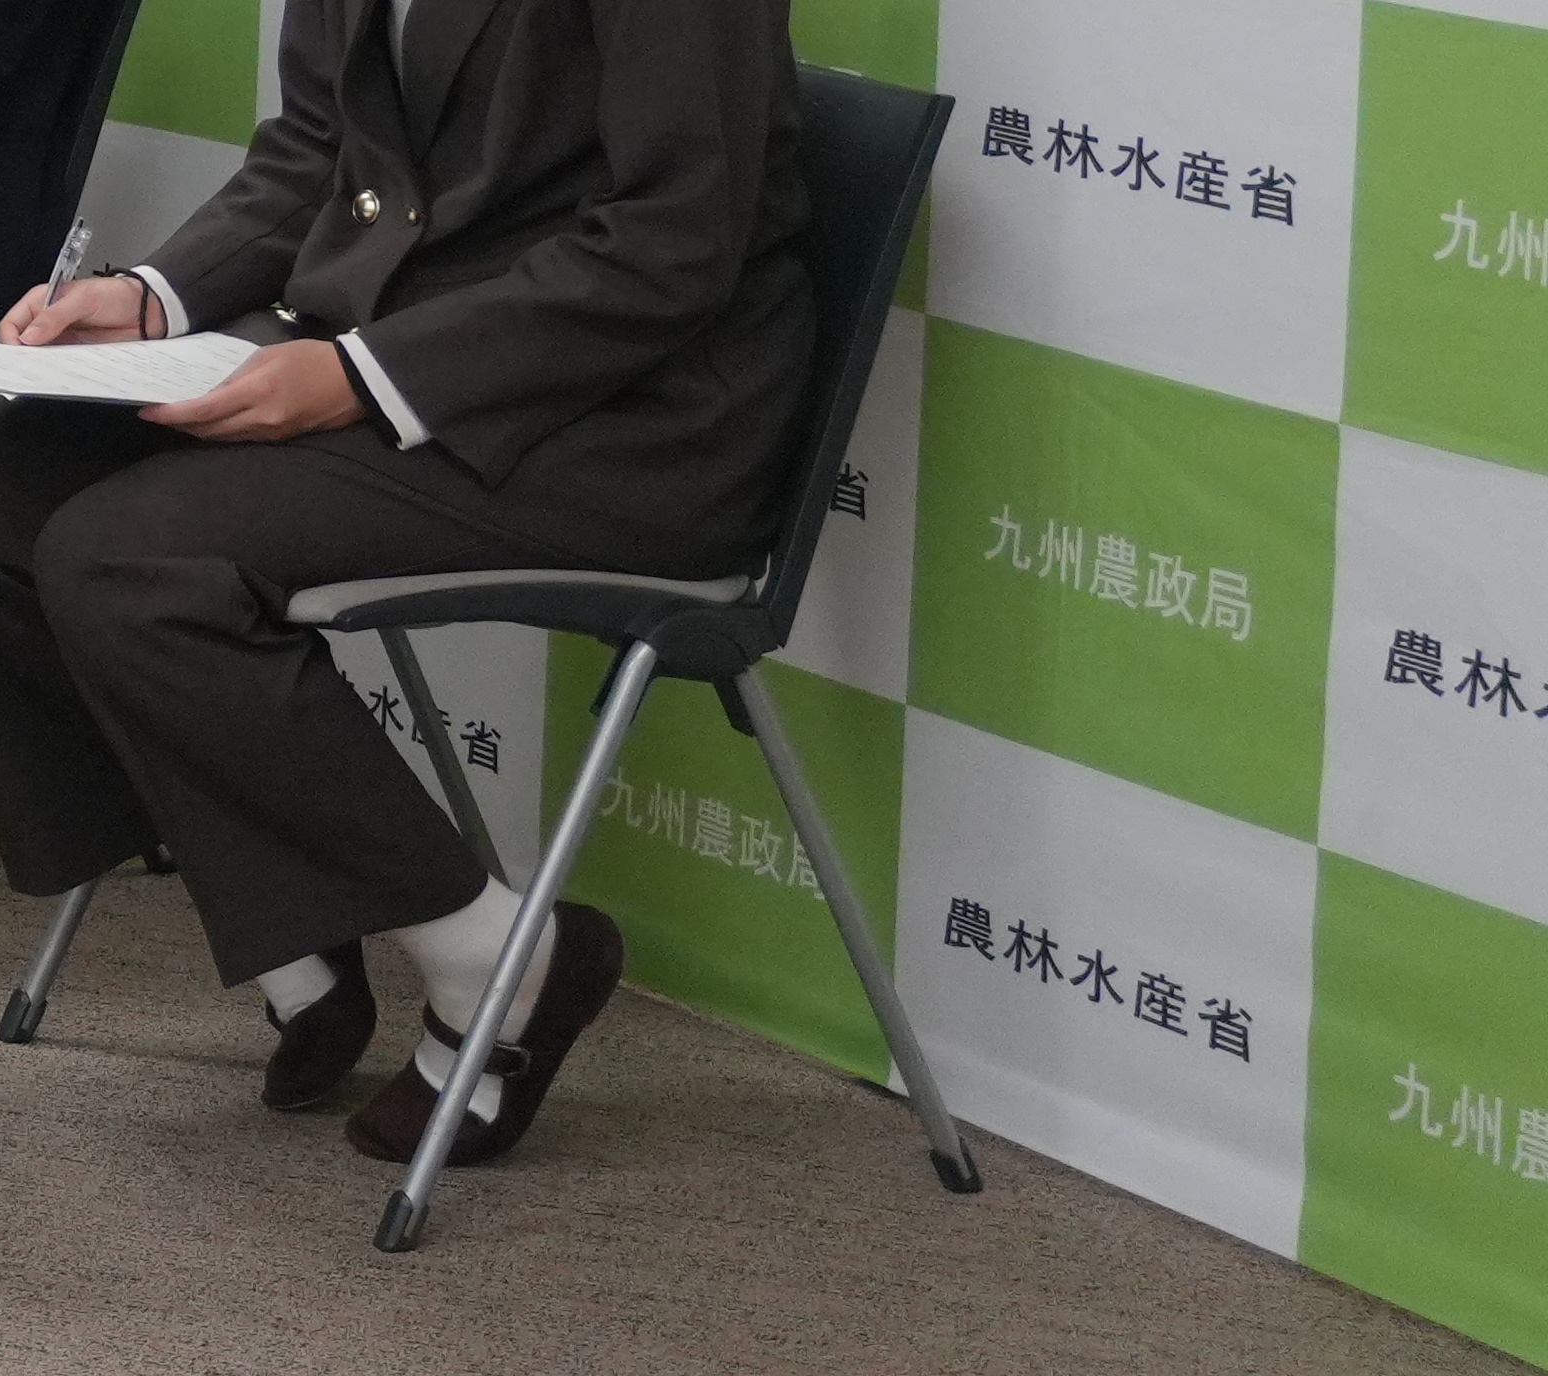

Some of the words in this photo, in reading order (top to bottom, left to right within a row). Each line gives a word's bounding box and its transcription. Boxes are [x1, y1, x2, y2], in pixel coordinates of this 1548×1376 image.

[980, 105, 1300, 227] 農林水産省
[984, 503, 1253, 643] 九州農政局
[1384, 628, 1548, 718] 農林
[943, 895, 1254, 1064] 農林水産省
